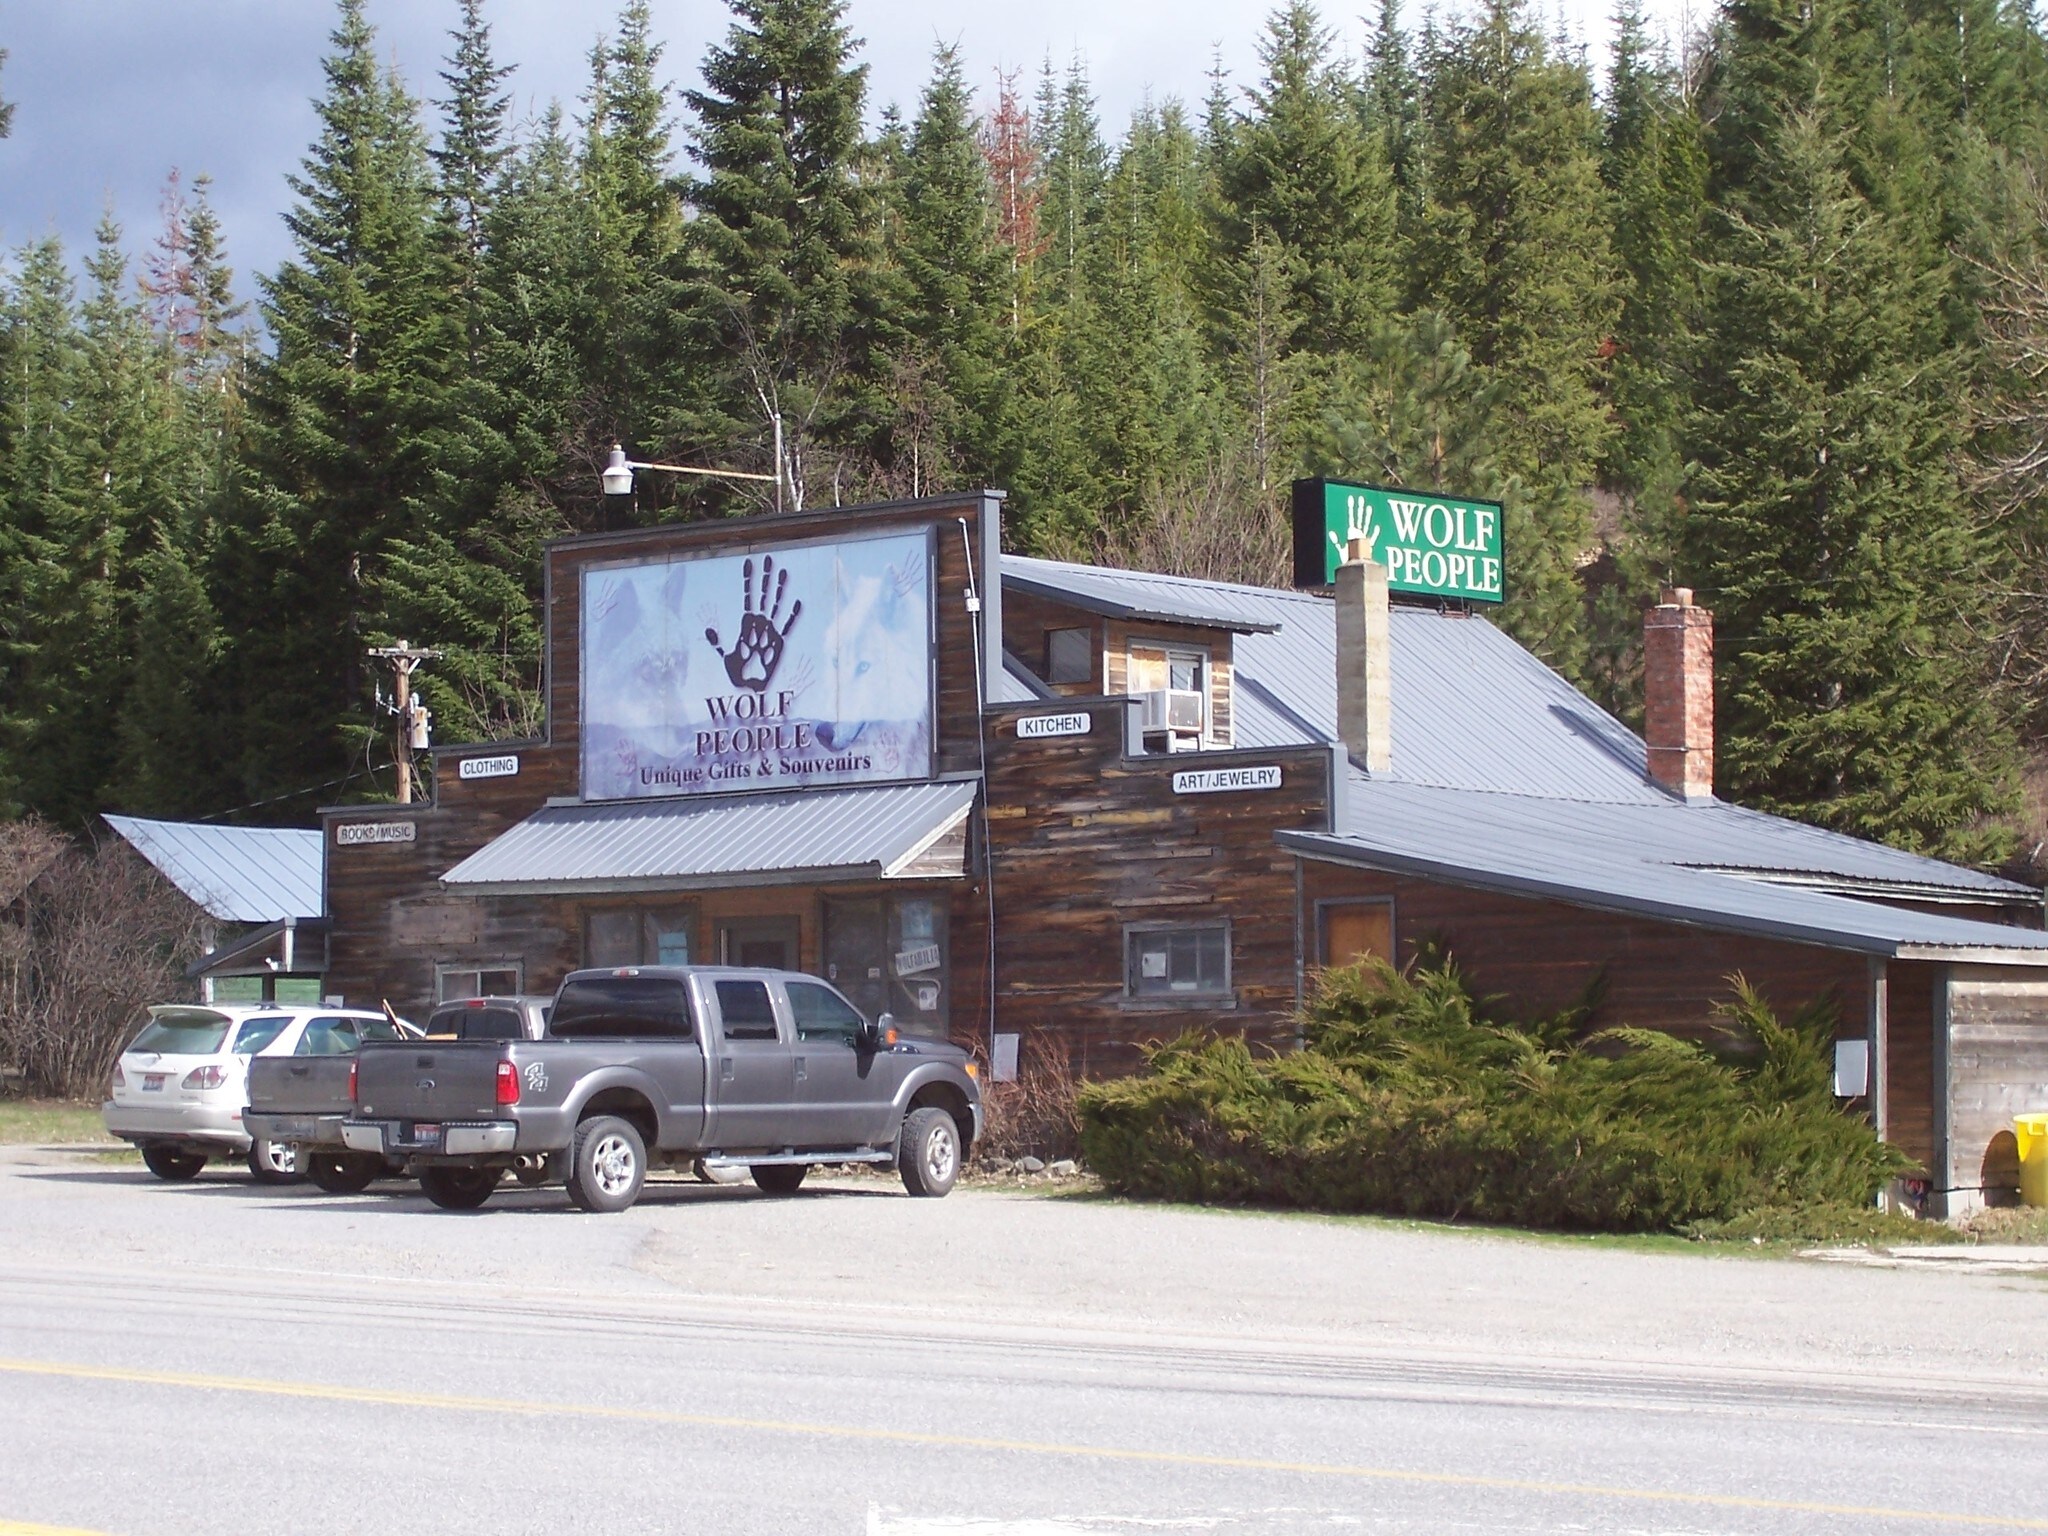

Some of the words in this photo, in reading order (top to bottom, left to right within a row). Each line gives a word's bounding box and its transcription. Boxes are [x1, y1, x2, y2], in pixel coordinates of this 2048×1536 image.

[1387, 498, 1495, 552] WOLF
[1385, 545, 1500, 593] PEOPLE
[705, 691, 794, 720] WOLF
[694, 723, 811, 756] PEOPLE
[1024, 716, 1083, 734] KITCHEN
[463, 758, 515, 775] CLOTHING
[640, 766, 703, 788] Unique
[708, 759, 751, 781] Gifts
[757, 757, 773, 776] &
[779, 751, 872, 775] Souvenirs
[1178, 768, 1277, 790] ART/JEWELRY
[341, 826, 411, 840] BOOKS/MUSIC
